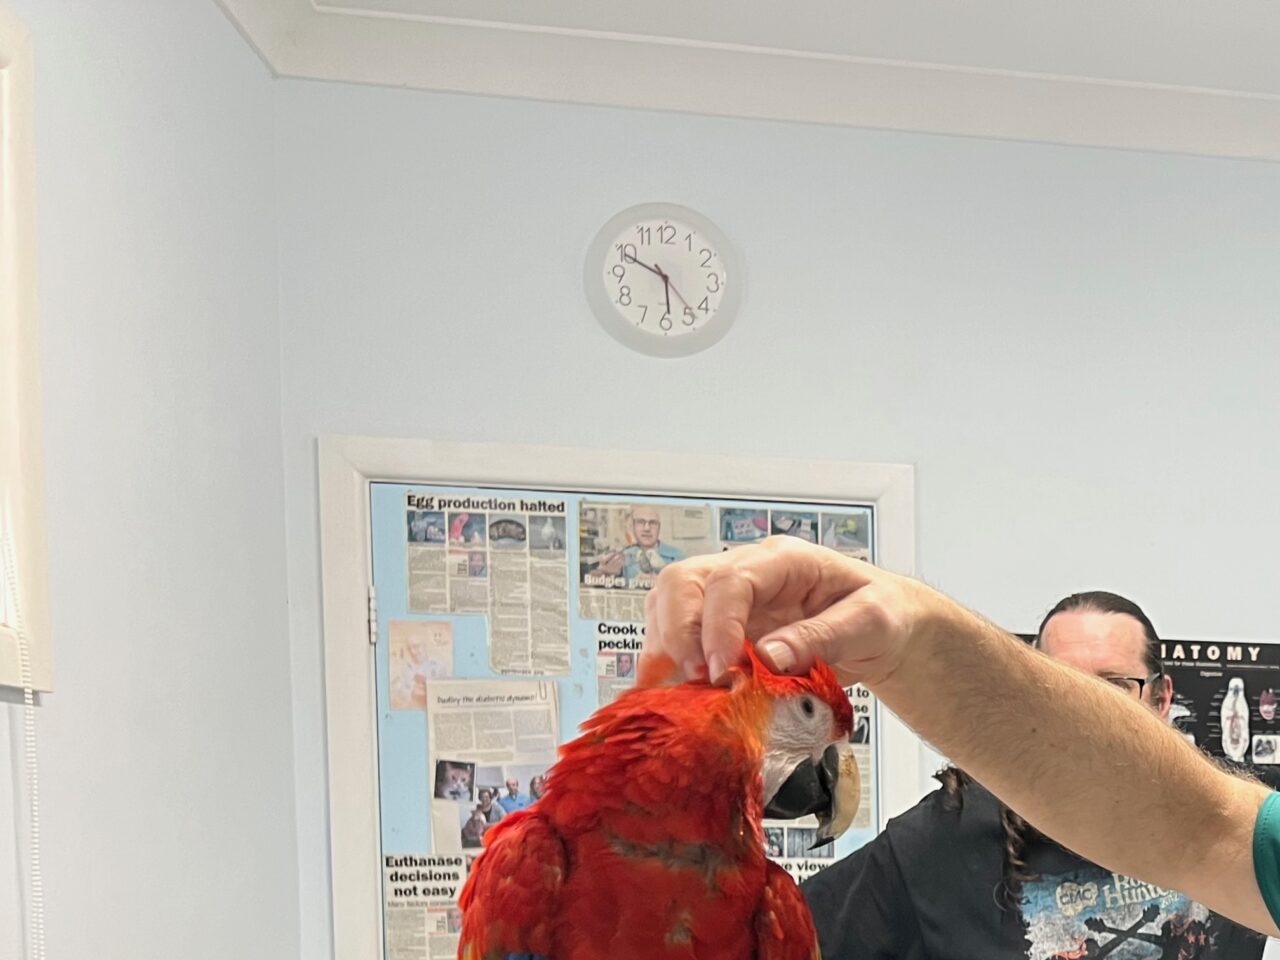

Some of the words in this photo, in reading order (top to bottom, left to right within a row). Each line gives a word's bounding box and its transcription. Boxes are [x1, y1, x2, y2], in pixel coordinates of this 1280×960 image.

[637, 226, 651, 246] 11
[656, 225, 676, 244] 12
[684, 234, 692, 252] 1
[616, 243, 637, 264] 10
[699, 248, 713, 268] 2
[612, 264, 626, 284] 9
[706, 272, 720, 294] 3
[619, 285, 632, 306] 8
[637, 304, 648, 323] 7
[697, 296, 710, 315] 4
[660, 311, 673, 331] 6
[682, 306, 696, 326] 5
[407, 495, 434, 510] Egg
[438, 498, 516, 510] production
[520, 499, 565, 512] halted
[598, 622, 638, 636] Crook
[599, 638, 642, 650] peckin
[386, 856, 462, 868] Euthanase
[390, 870, 460, 882] decisions
[394, 886, 418, 896] not
[422, 886, 456, 898] easy
